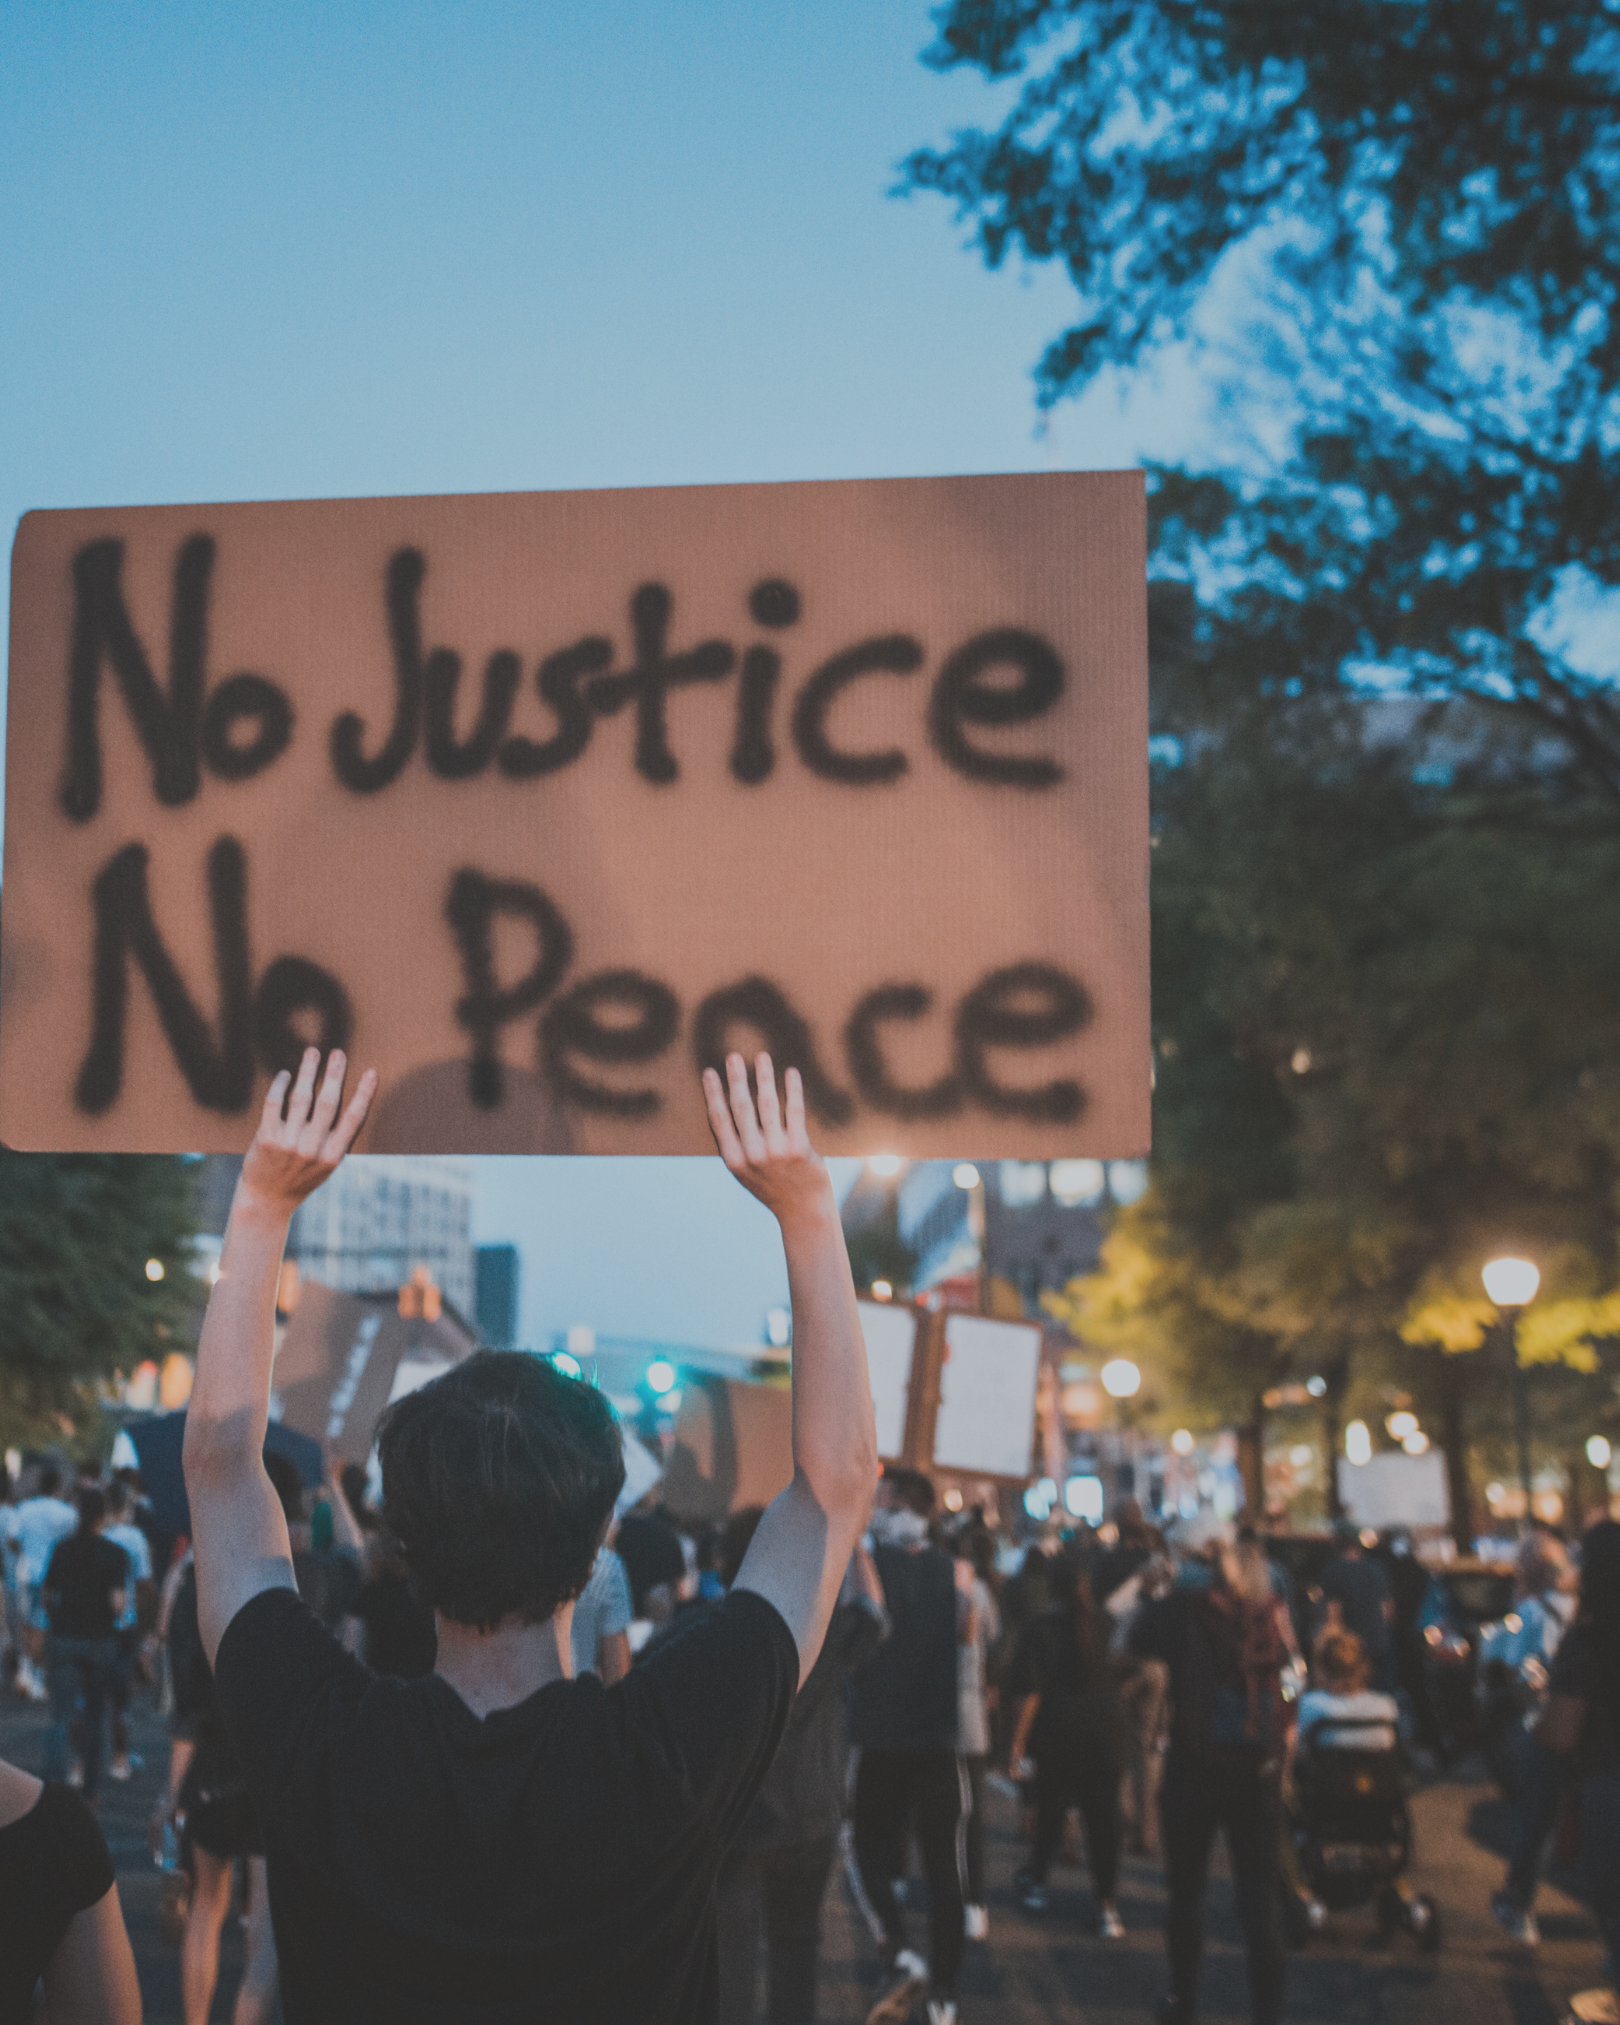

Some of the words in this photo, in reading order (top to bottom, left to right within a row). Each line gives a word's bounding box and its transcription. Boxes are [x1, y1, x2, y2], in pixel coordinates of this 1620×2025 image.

[60, 533, 293, 820] No
[330, 545, 1067, 793] Justice
[75, 837, 350, 1115] No
[447, 867, 1092, 1126] Peace
